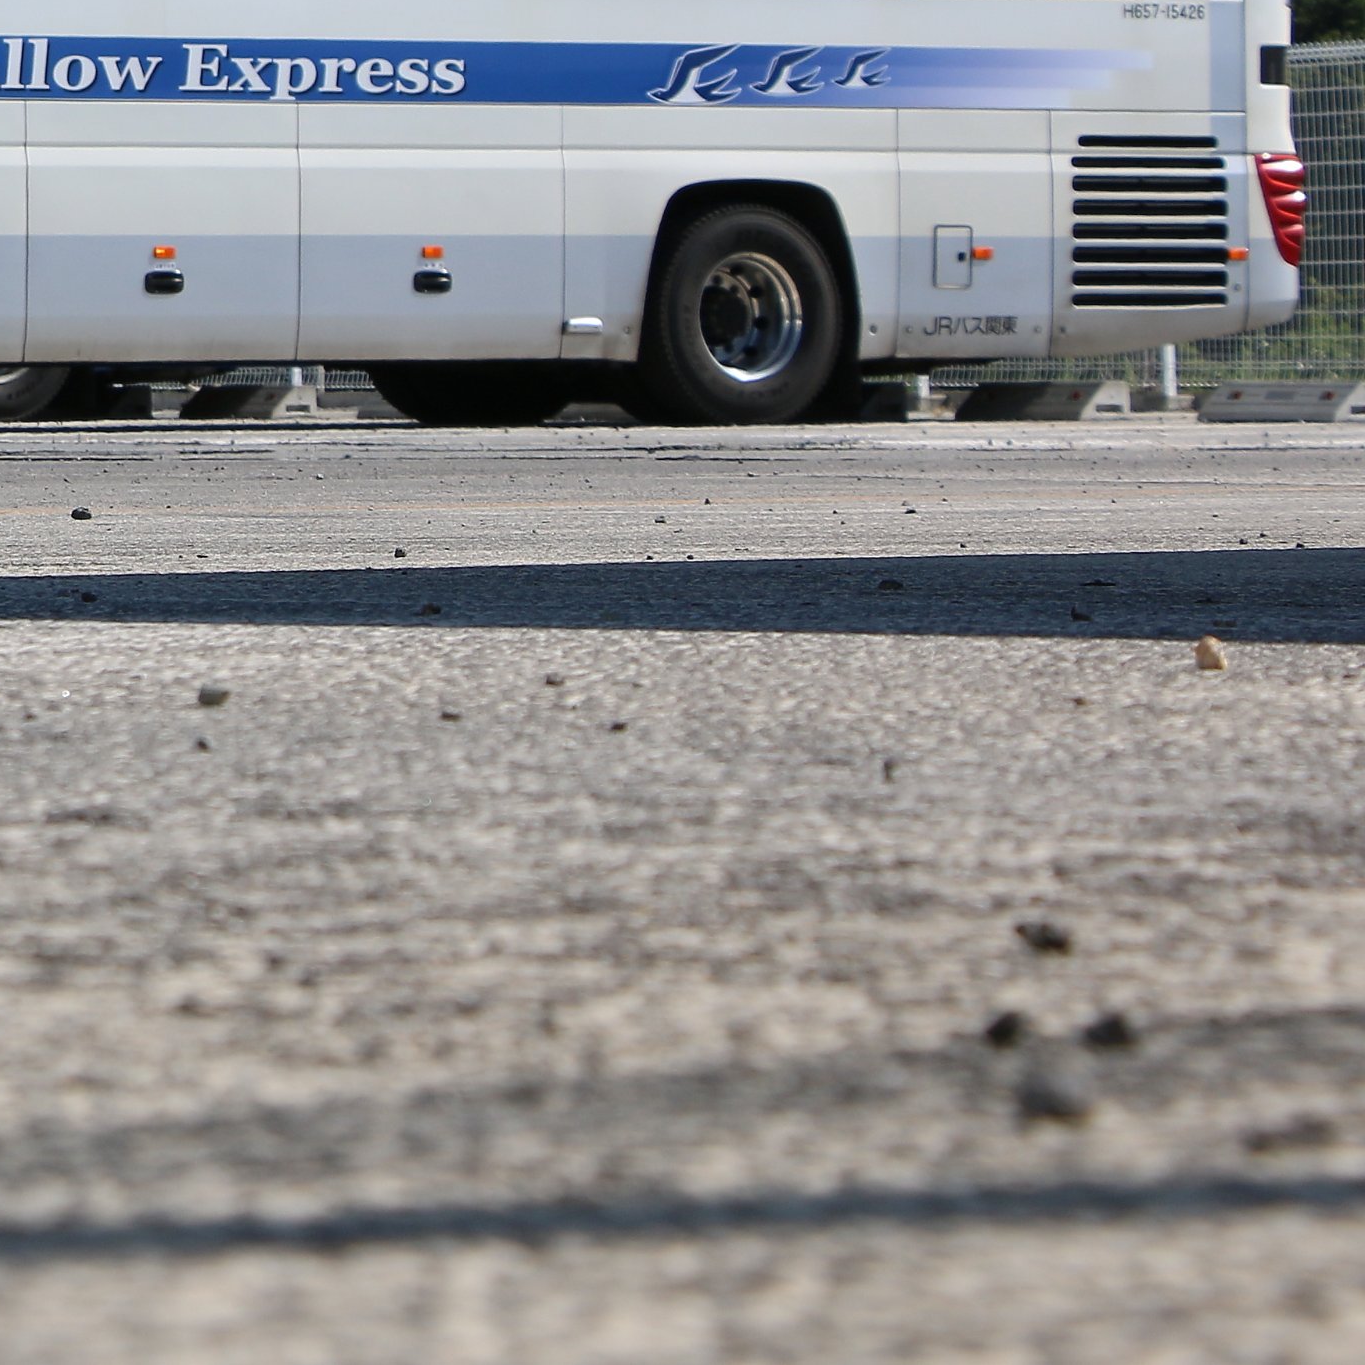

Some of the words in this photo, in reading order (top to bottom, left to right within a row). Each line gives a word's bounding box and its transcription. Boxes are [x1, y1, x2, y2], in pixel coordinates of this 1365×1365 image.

[1122, 3, 1205, 20] H657-15426
[178, 42, 466, 102] Express
[923, 315, 1019, 336] JRバス関東
